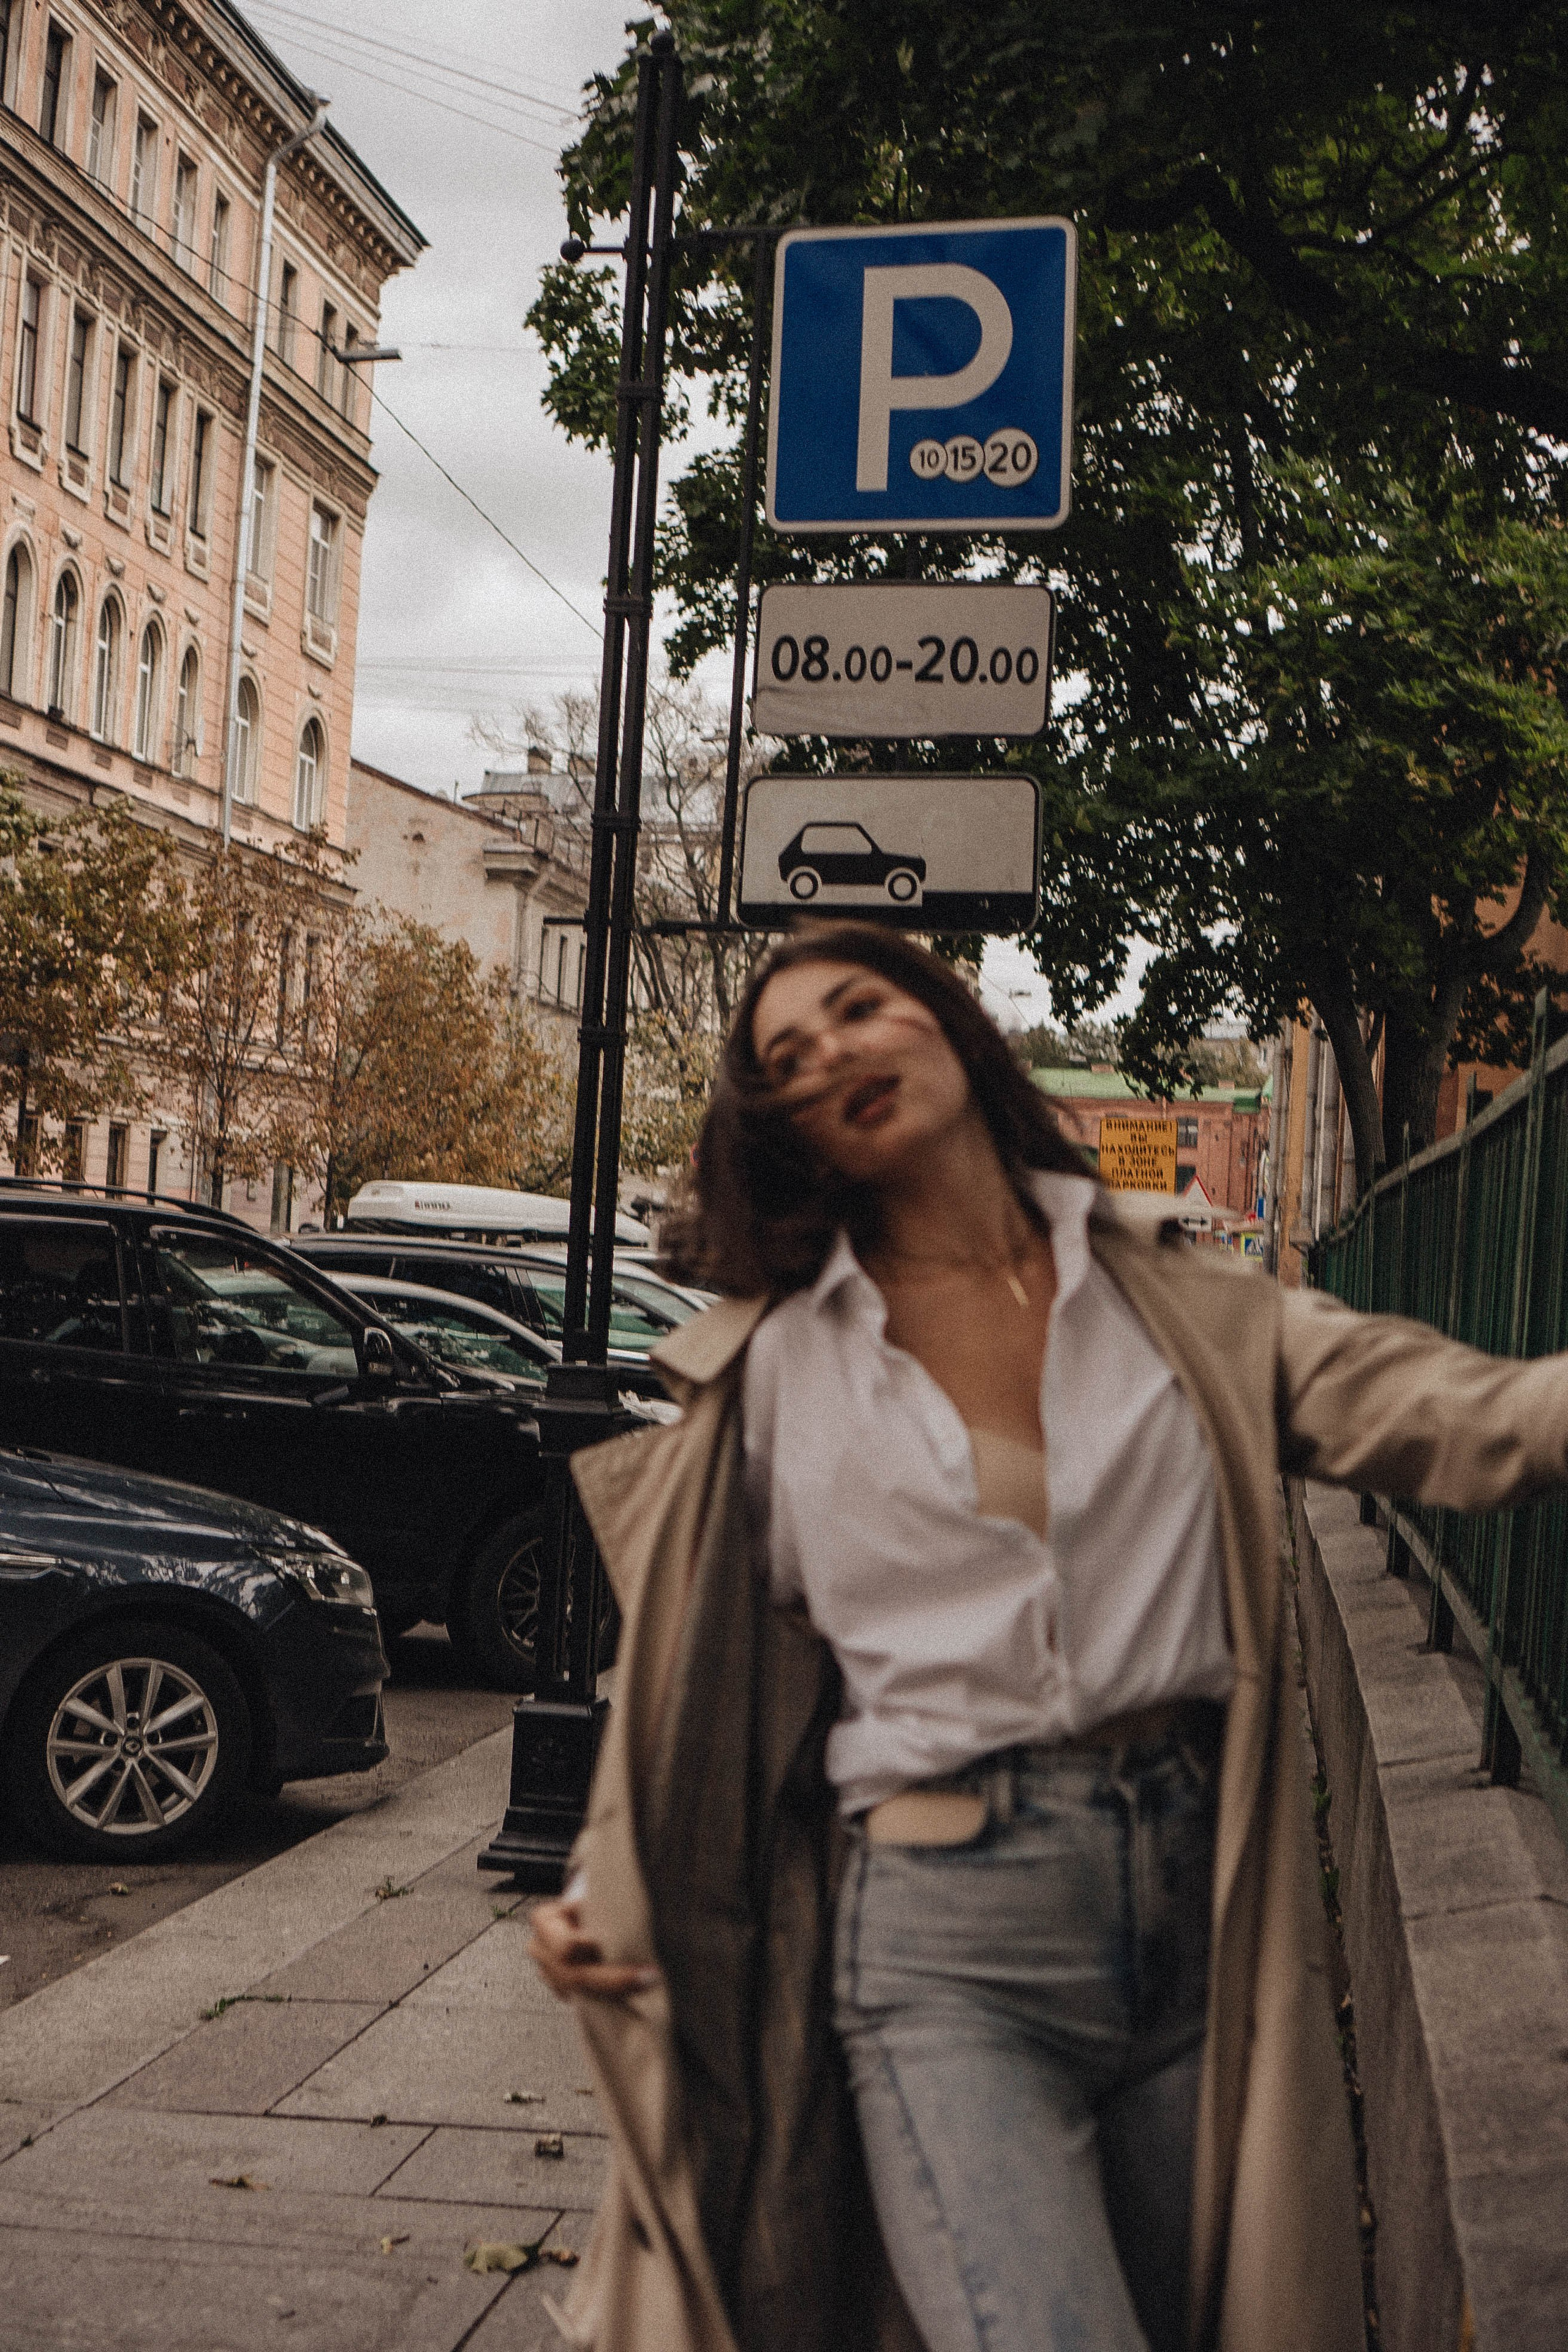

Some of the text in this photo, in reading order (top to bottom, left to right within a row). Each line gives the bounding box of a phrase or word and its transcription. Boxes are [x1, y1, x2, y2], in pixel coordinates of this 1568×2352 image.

[856, 263, 1013, 492] P
[919, 442, 1032, 474] 10 15 20
[771, 634, 1039, 685] 08.00-20.00
